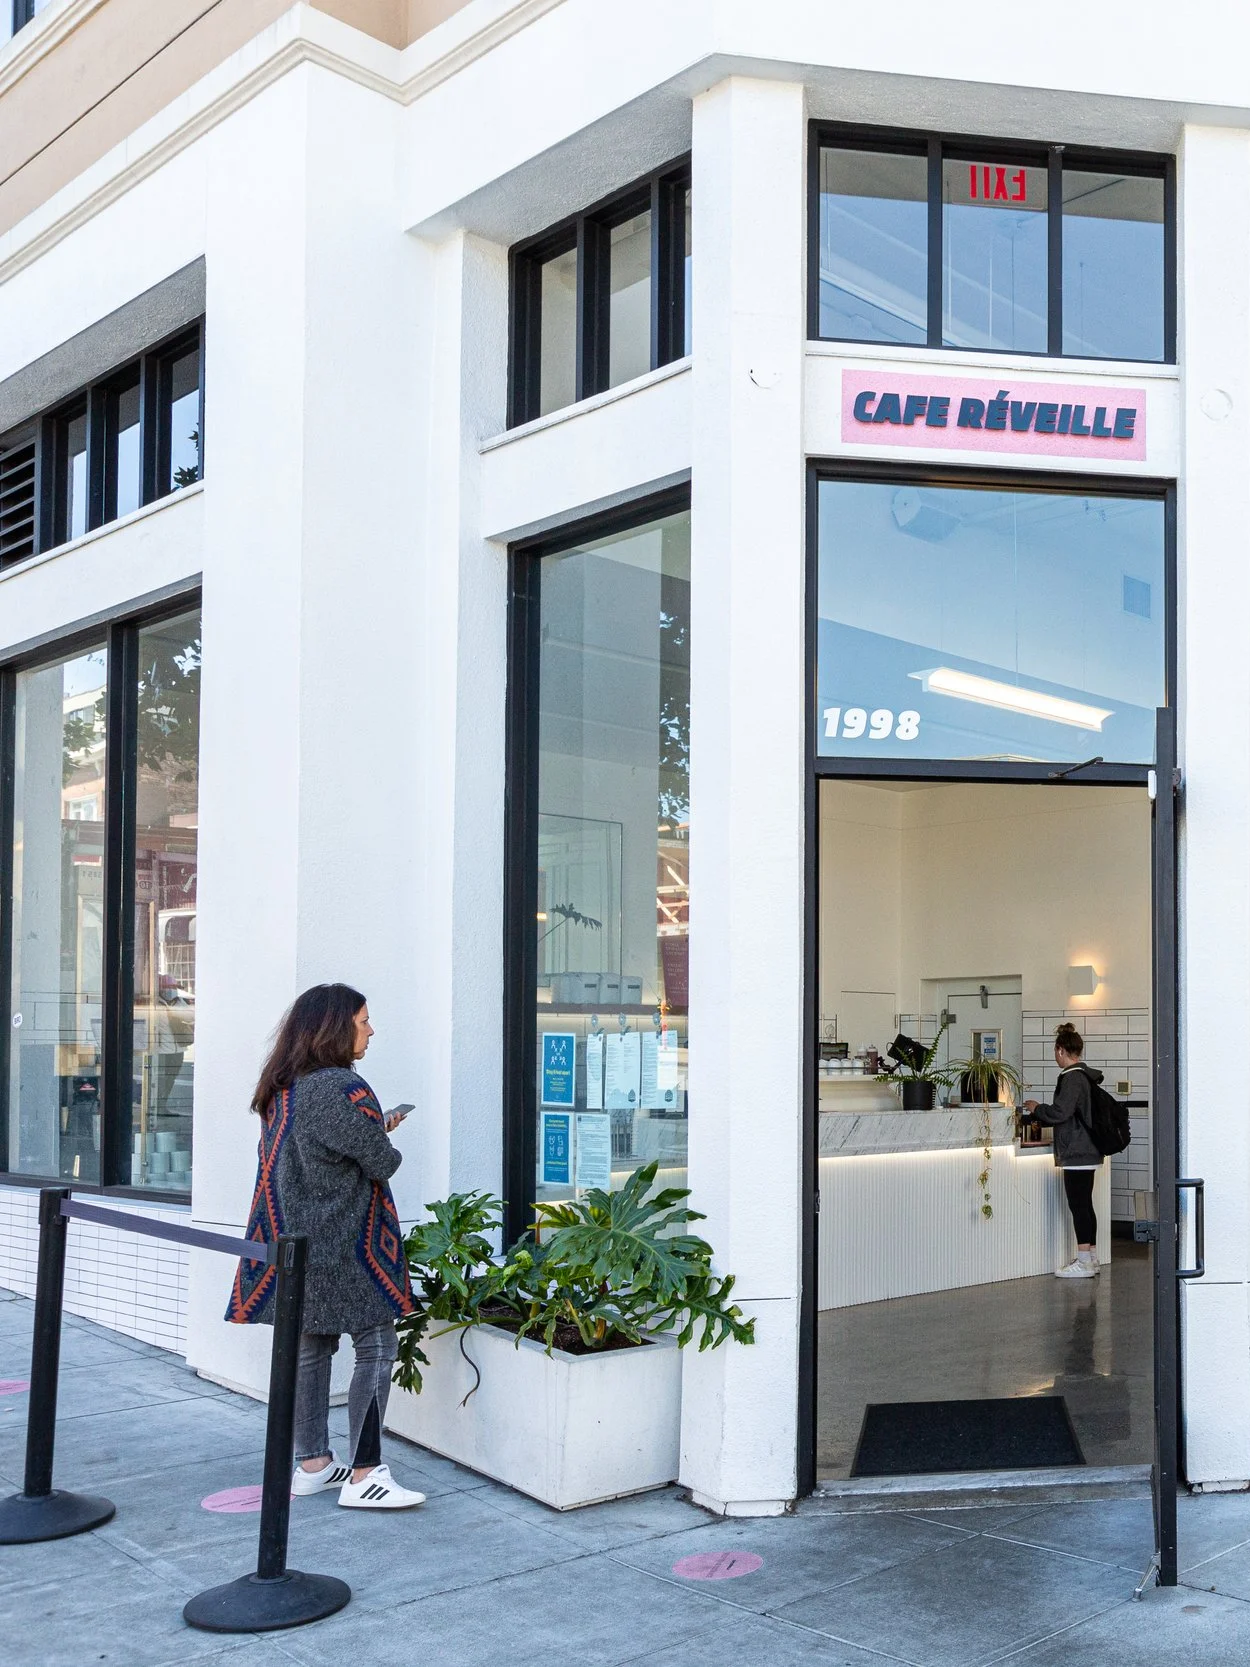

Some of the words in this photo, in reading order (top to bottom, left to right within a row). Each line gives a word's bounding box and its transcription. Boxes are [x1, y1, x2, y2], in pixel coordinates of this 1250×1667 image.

[853, 391, 950, 427] CAFE
[957, 390, 1137, 438] RÉVEILLE
[823, 707, 921, 741] 1998
